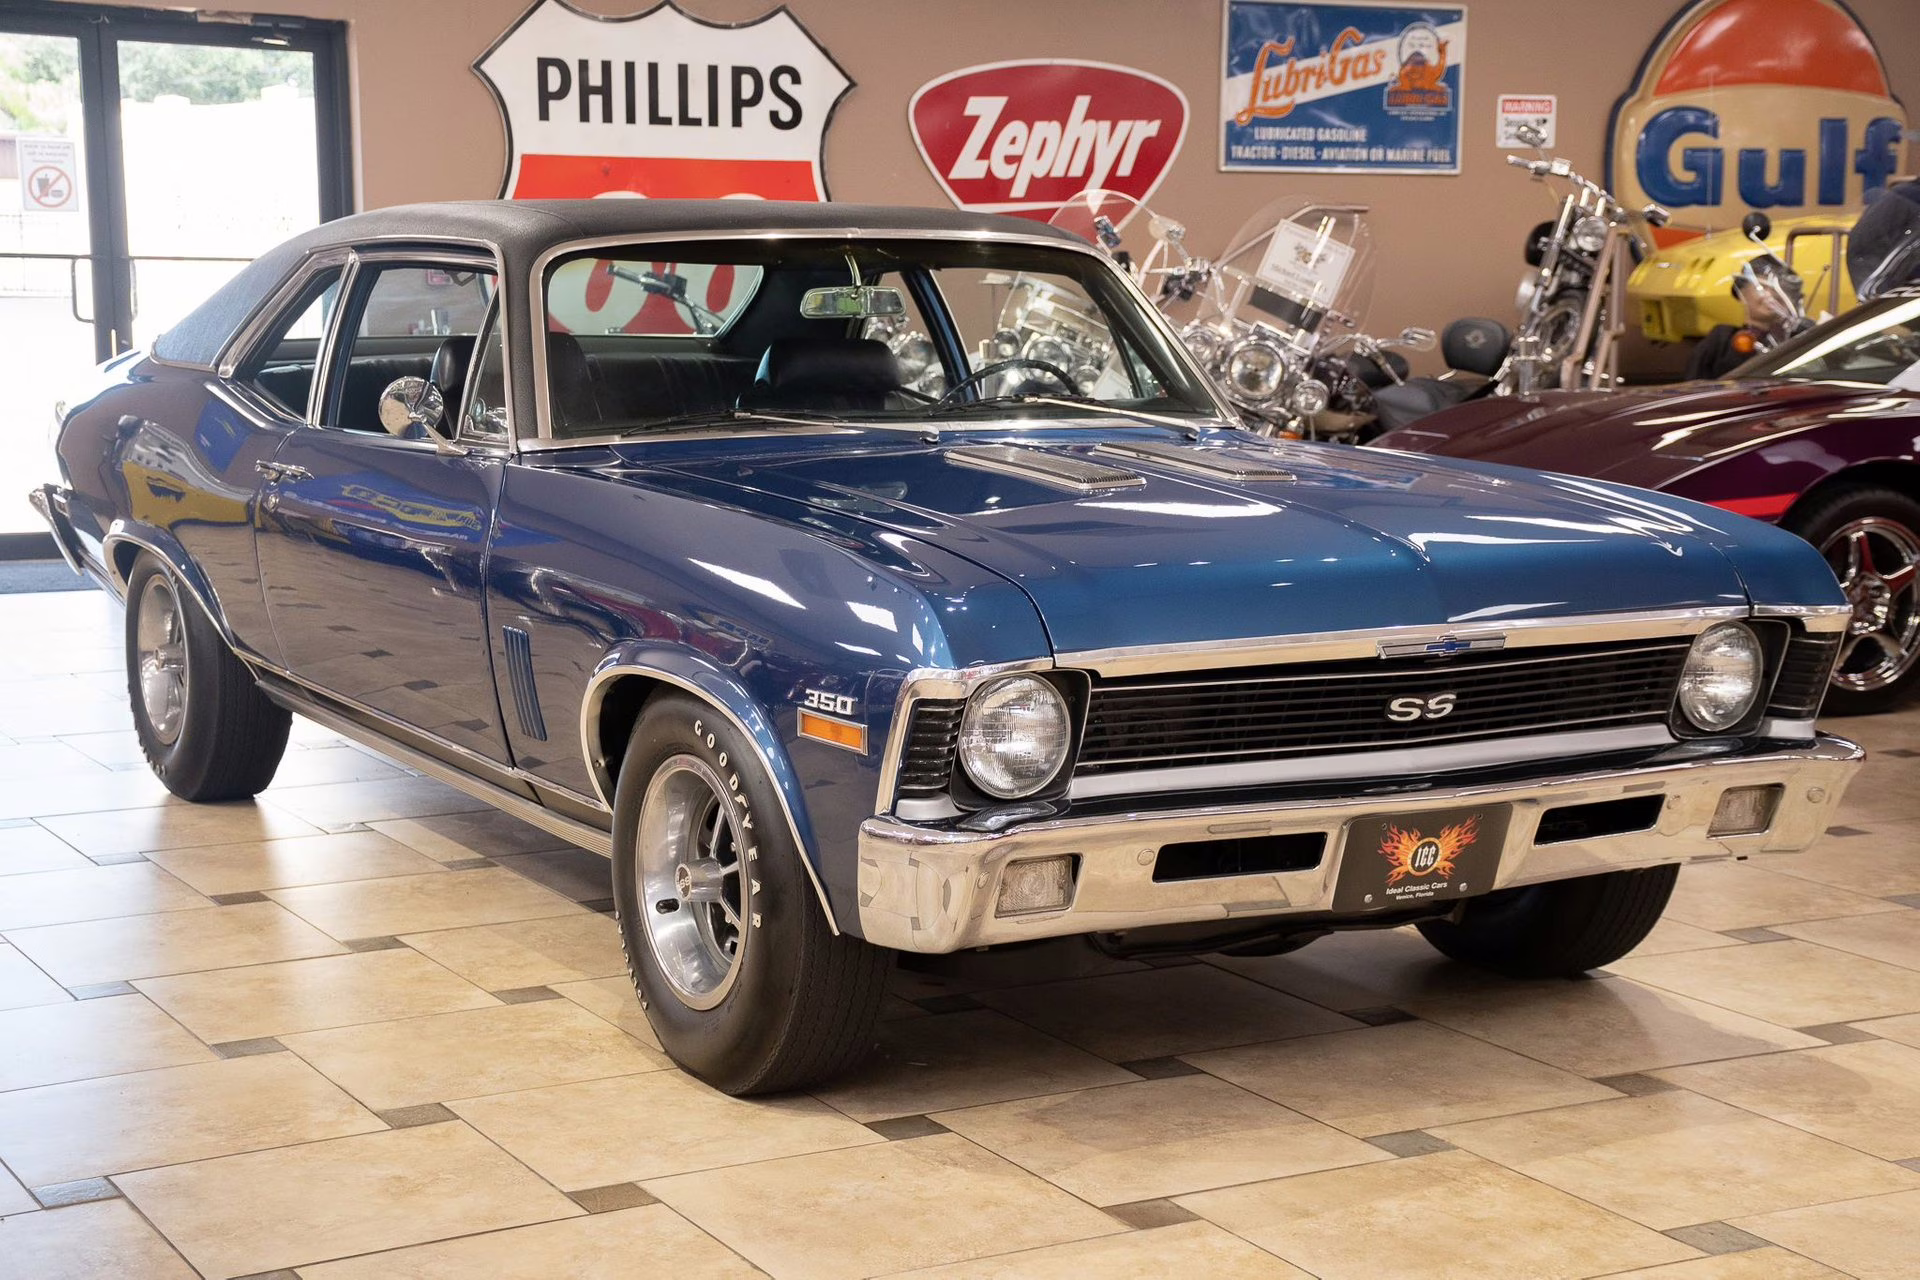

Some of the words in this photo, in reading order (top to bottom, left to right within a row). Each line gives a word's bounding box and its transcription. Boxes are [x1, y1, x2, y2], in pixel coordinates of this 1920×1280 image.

[537, 57, 802, 130] PHILLIPS
[1254, 127, 1315, 141] LUBRICATED
[1317, 128, 1367, 142] GASOLINE
[948, 95, 1162, 212] Zephyr
[1232, 145, 1277, 159] TRACTOR
[1281, 146, 1316, 160] DIESEL
[1321, 147, 1368, 160] AVIATION
[1370, 147, 1385, 161] OR
[1386, 148, 1425, 162] MARINE
[1427, 149, 1451, 162] FUEL
[1636, 105, 1903, 208] Gulf
[804, 688, 854, 715] 350
[1388, 693, 1457, 721] SS
[694, 719, 763, 929] GOODYEAR
[1386, 886, 1404, 895] Ideal
[1405, 884, 1430, 892] Classic
